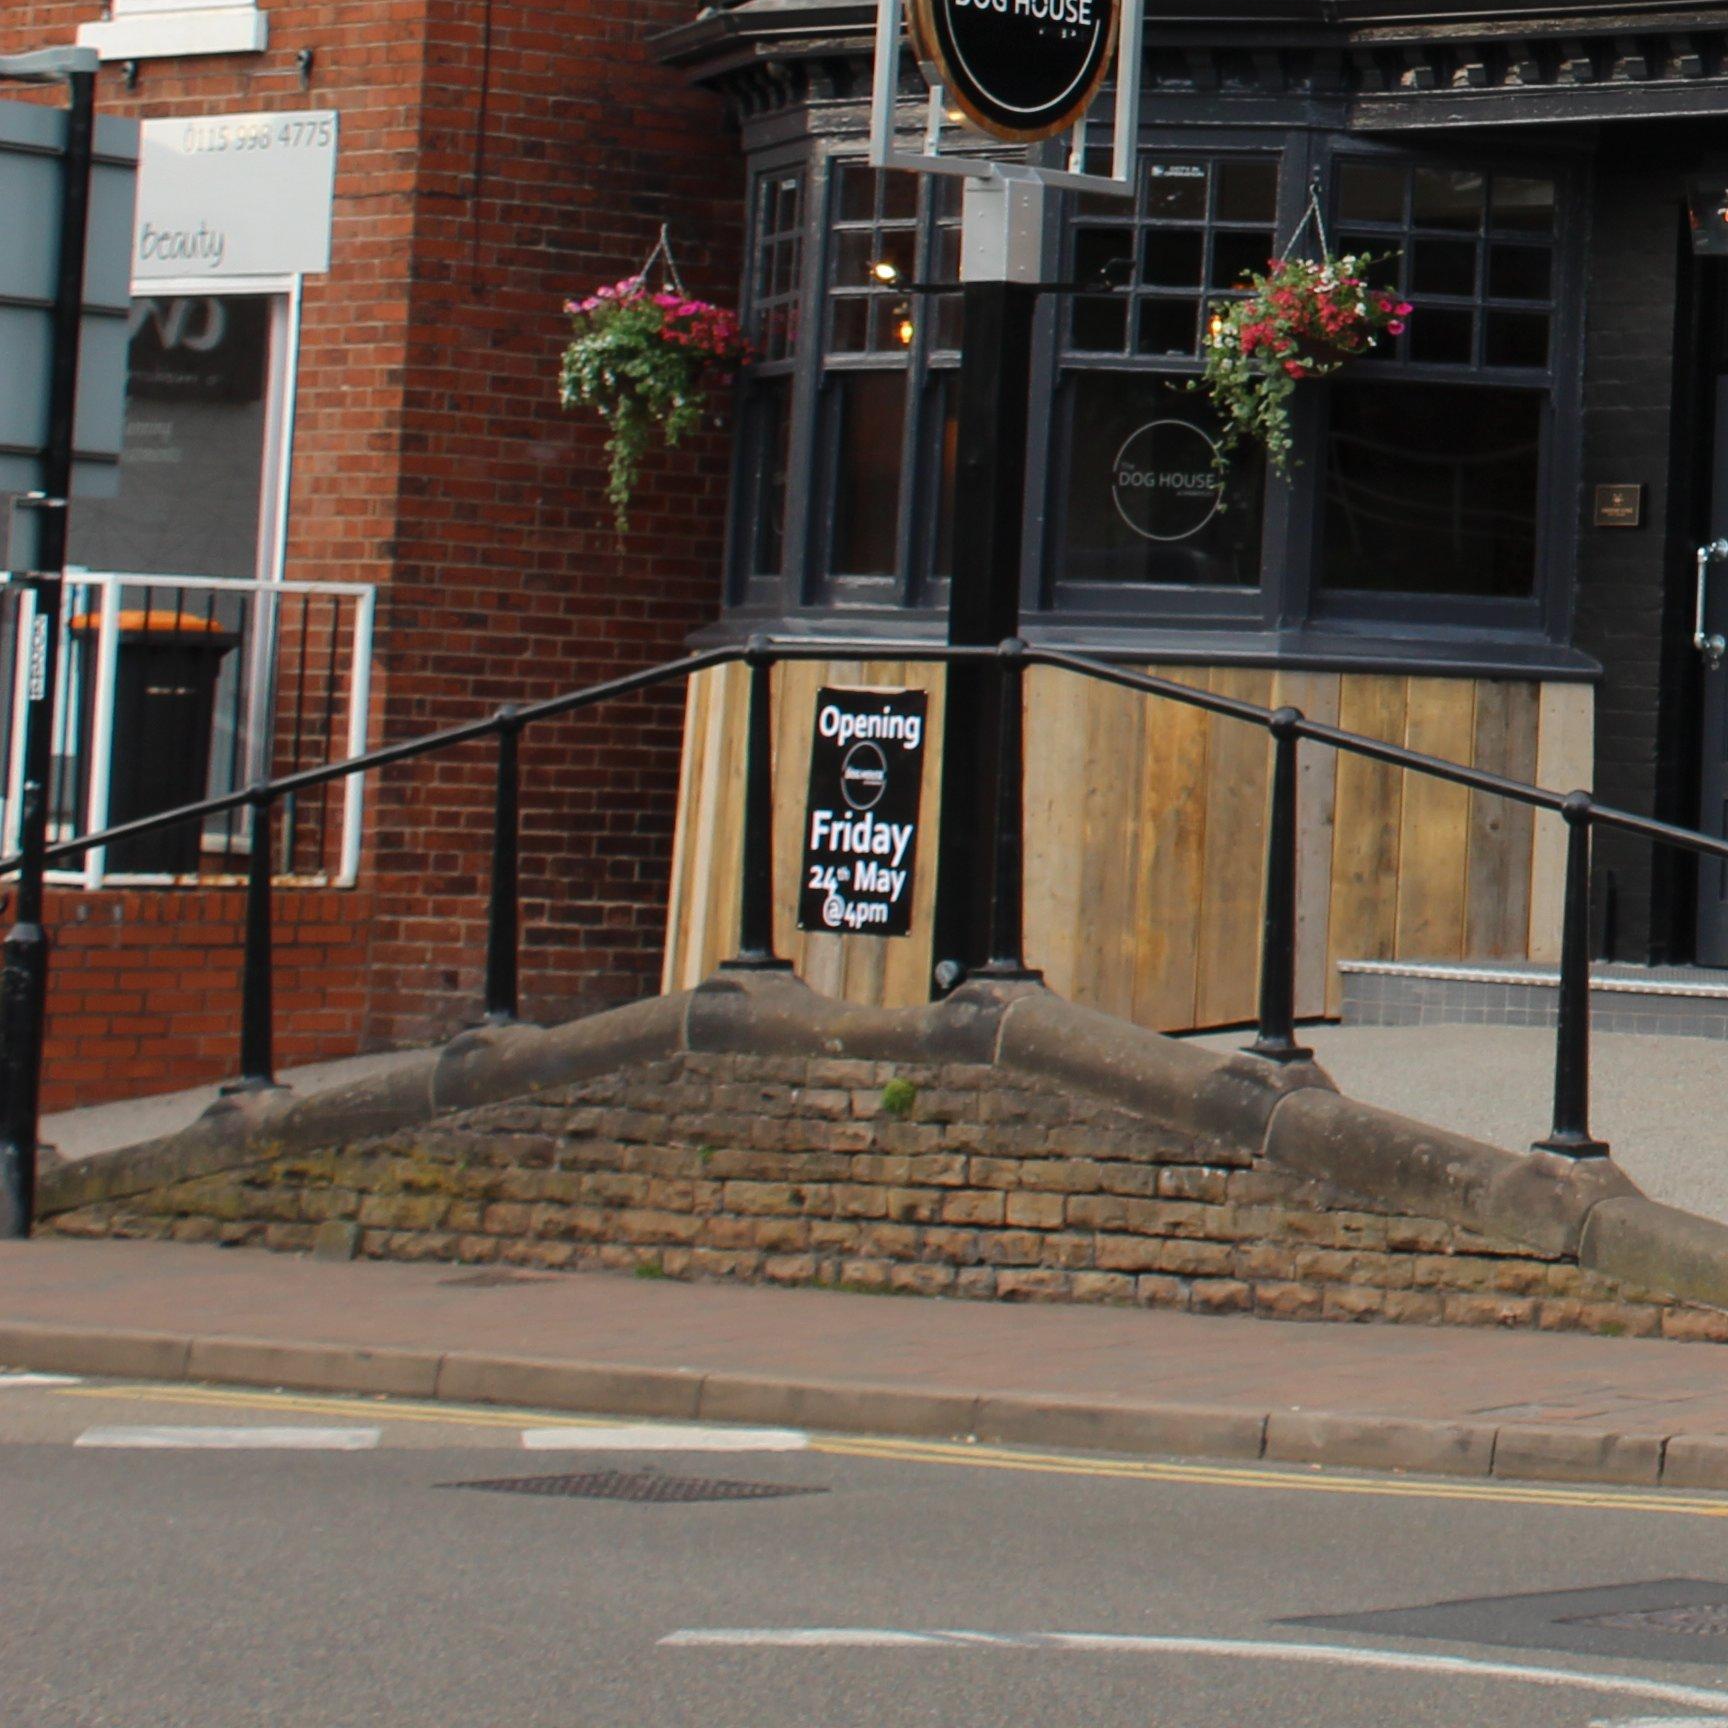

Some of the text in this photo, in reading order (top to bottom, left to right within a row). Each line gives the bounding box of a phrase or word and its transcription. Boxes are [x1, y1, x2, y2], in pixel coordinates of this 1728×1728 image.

[277, 121, 332, 148] 4775
[140, 222, 225, 268] beauty
[1118, 471, 1216, 489] DOG HOUSE
[819, 705, 922, 750] Opening
[810, 810, 913, 868] Friday
[808, 860, 907, 903] 24th May
[823, 894, 889, 929] @4pm
